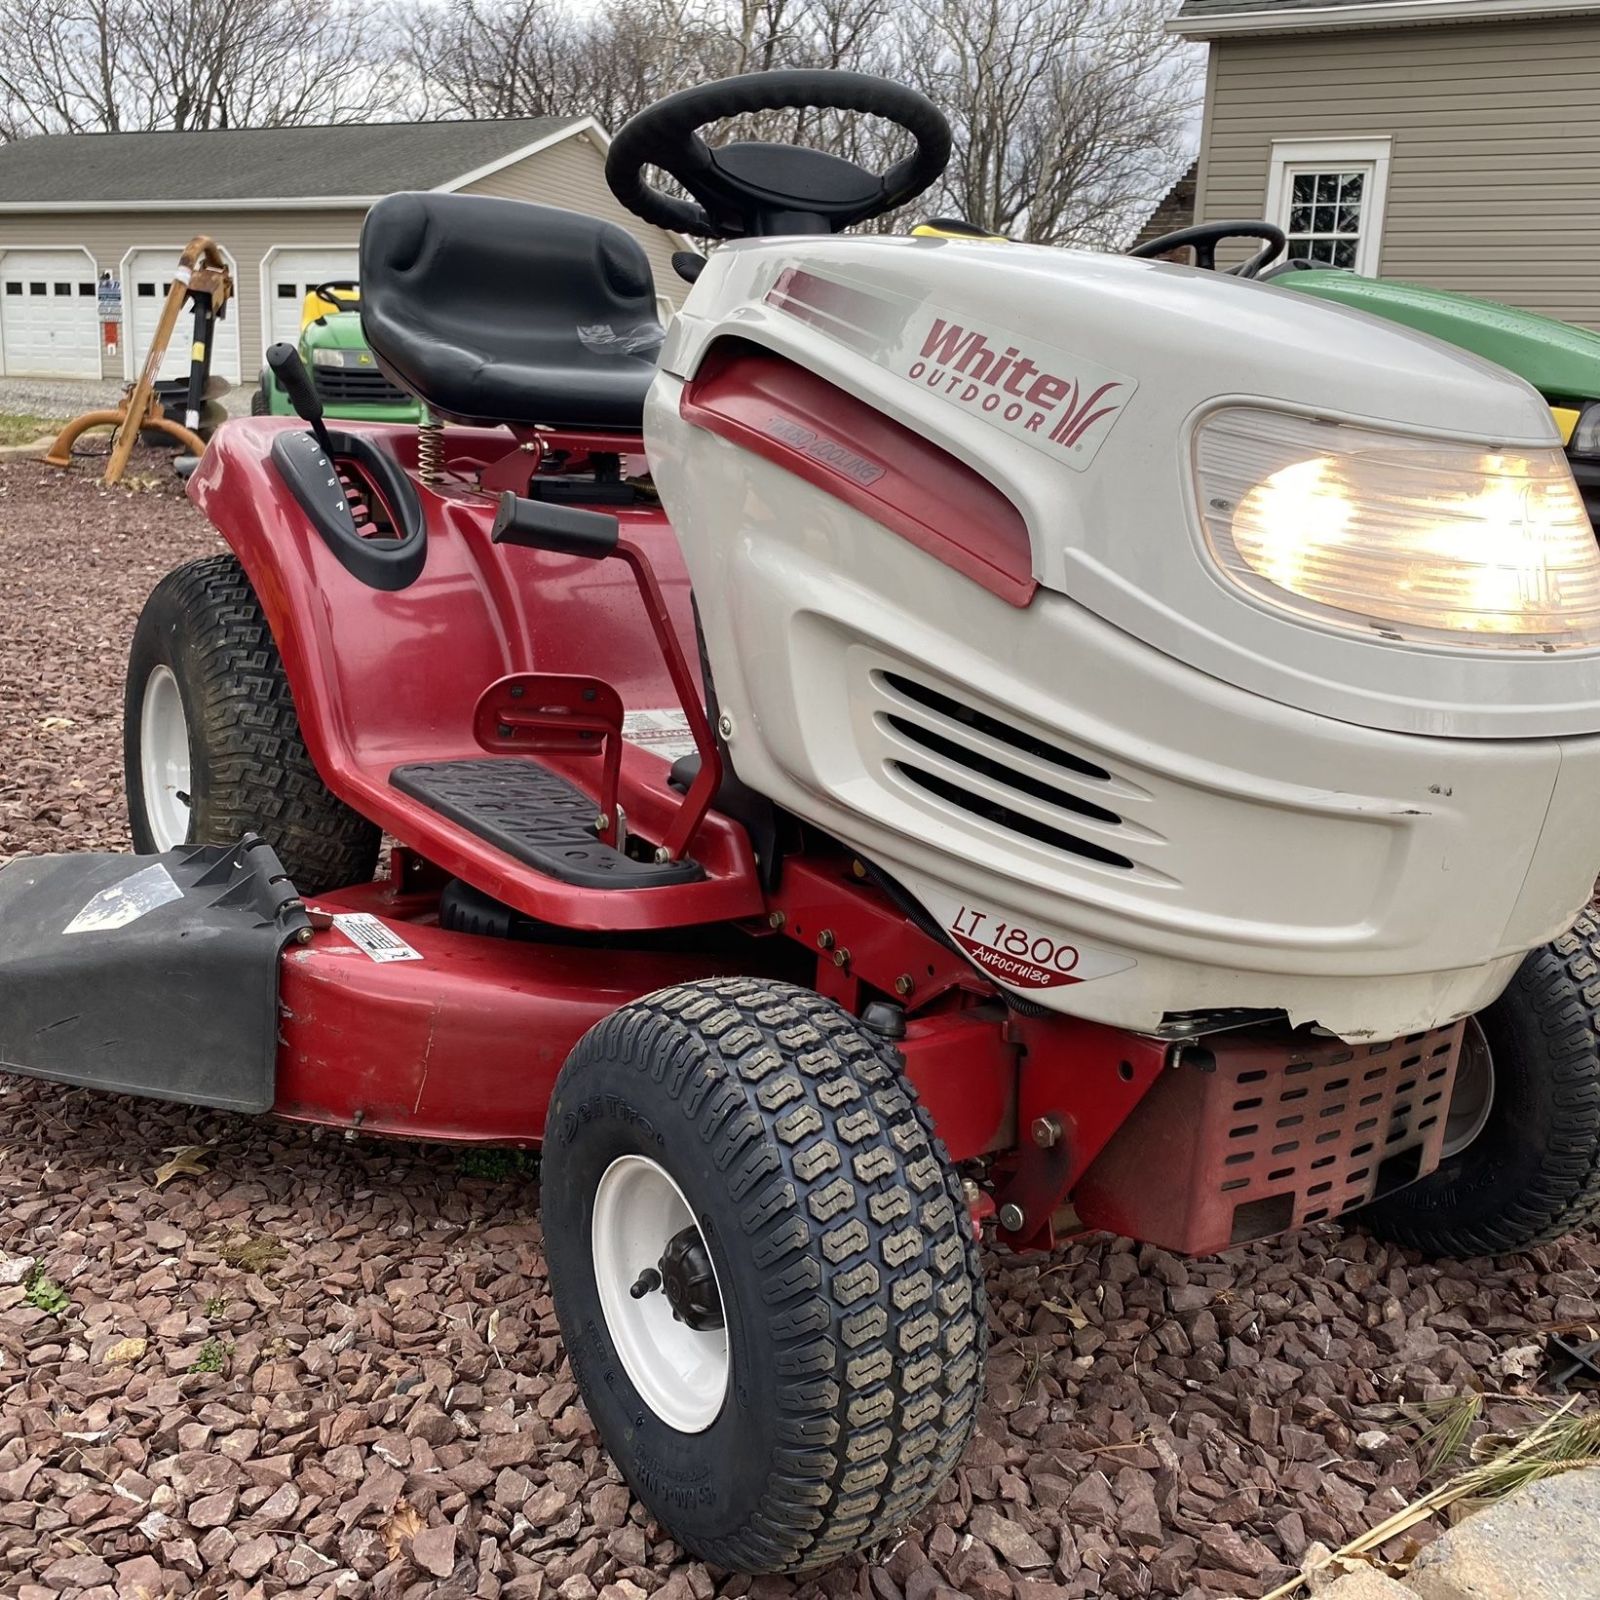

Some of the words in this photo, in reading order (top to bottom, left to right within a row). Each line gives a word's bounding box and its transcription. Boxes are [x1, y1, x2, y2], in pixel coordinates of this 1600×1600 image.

[909, 362, 1046, 433] OUTDOOR
[919, 318, 1071, 411] White
[811, 438, 877, 480] COOLING
[952, 906, 987, 937] LT
[993, 923, 1079, 972] 1800
[971, 946, 1051, 985] Autocruise
